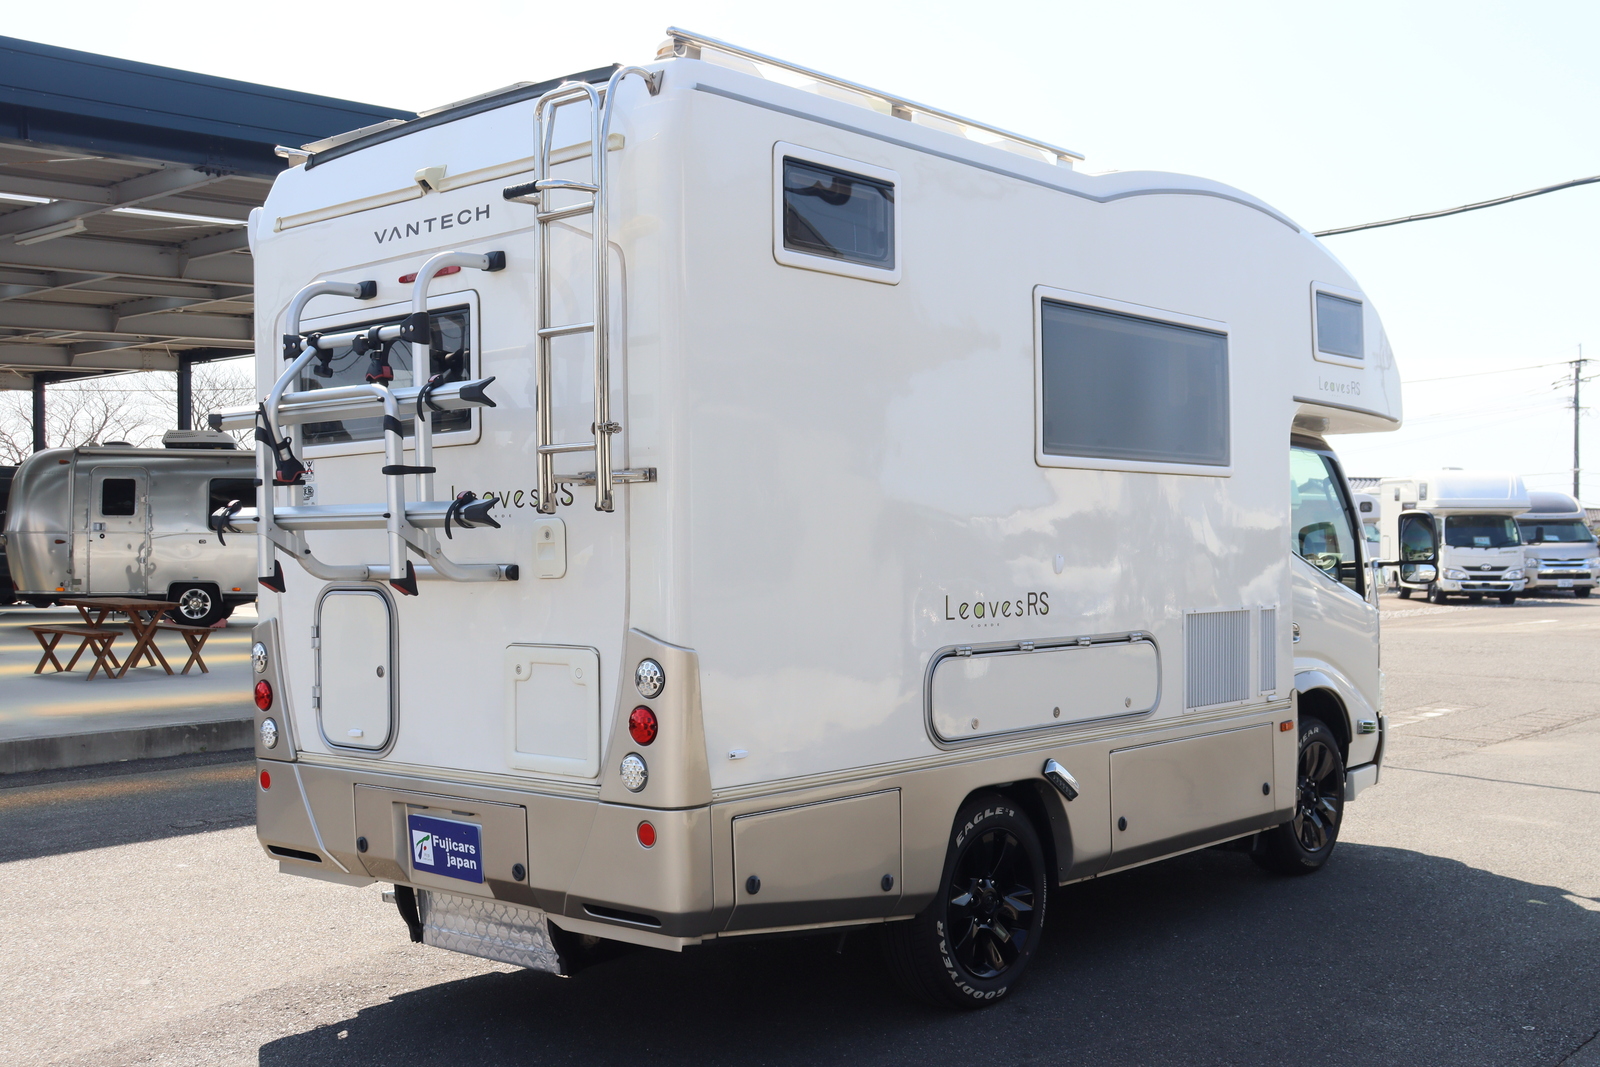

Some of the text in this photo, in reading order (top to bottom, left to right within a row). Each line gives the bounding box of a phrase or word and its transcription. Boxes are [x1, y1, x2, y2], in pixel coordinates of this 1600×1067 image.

[373, 203, 491, 245] VANTECH
[432, 834, 476, 855] Fujicars
[446, 852, 477, 870] japan
